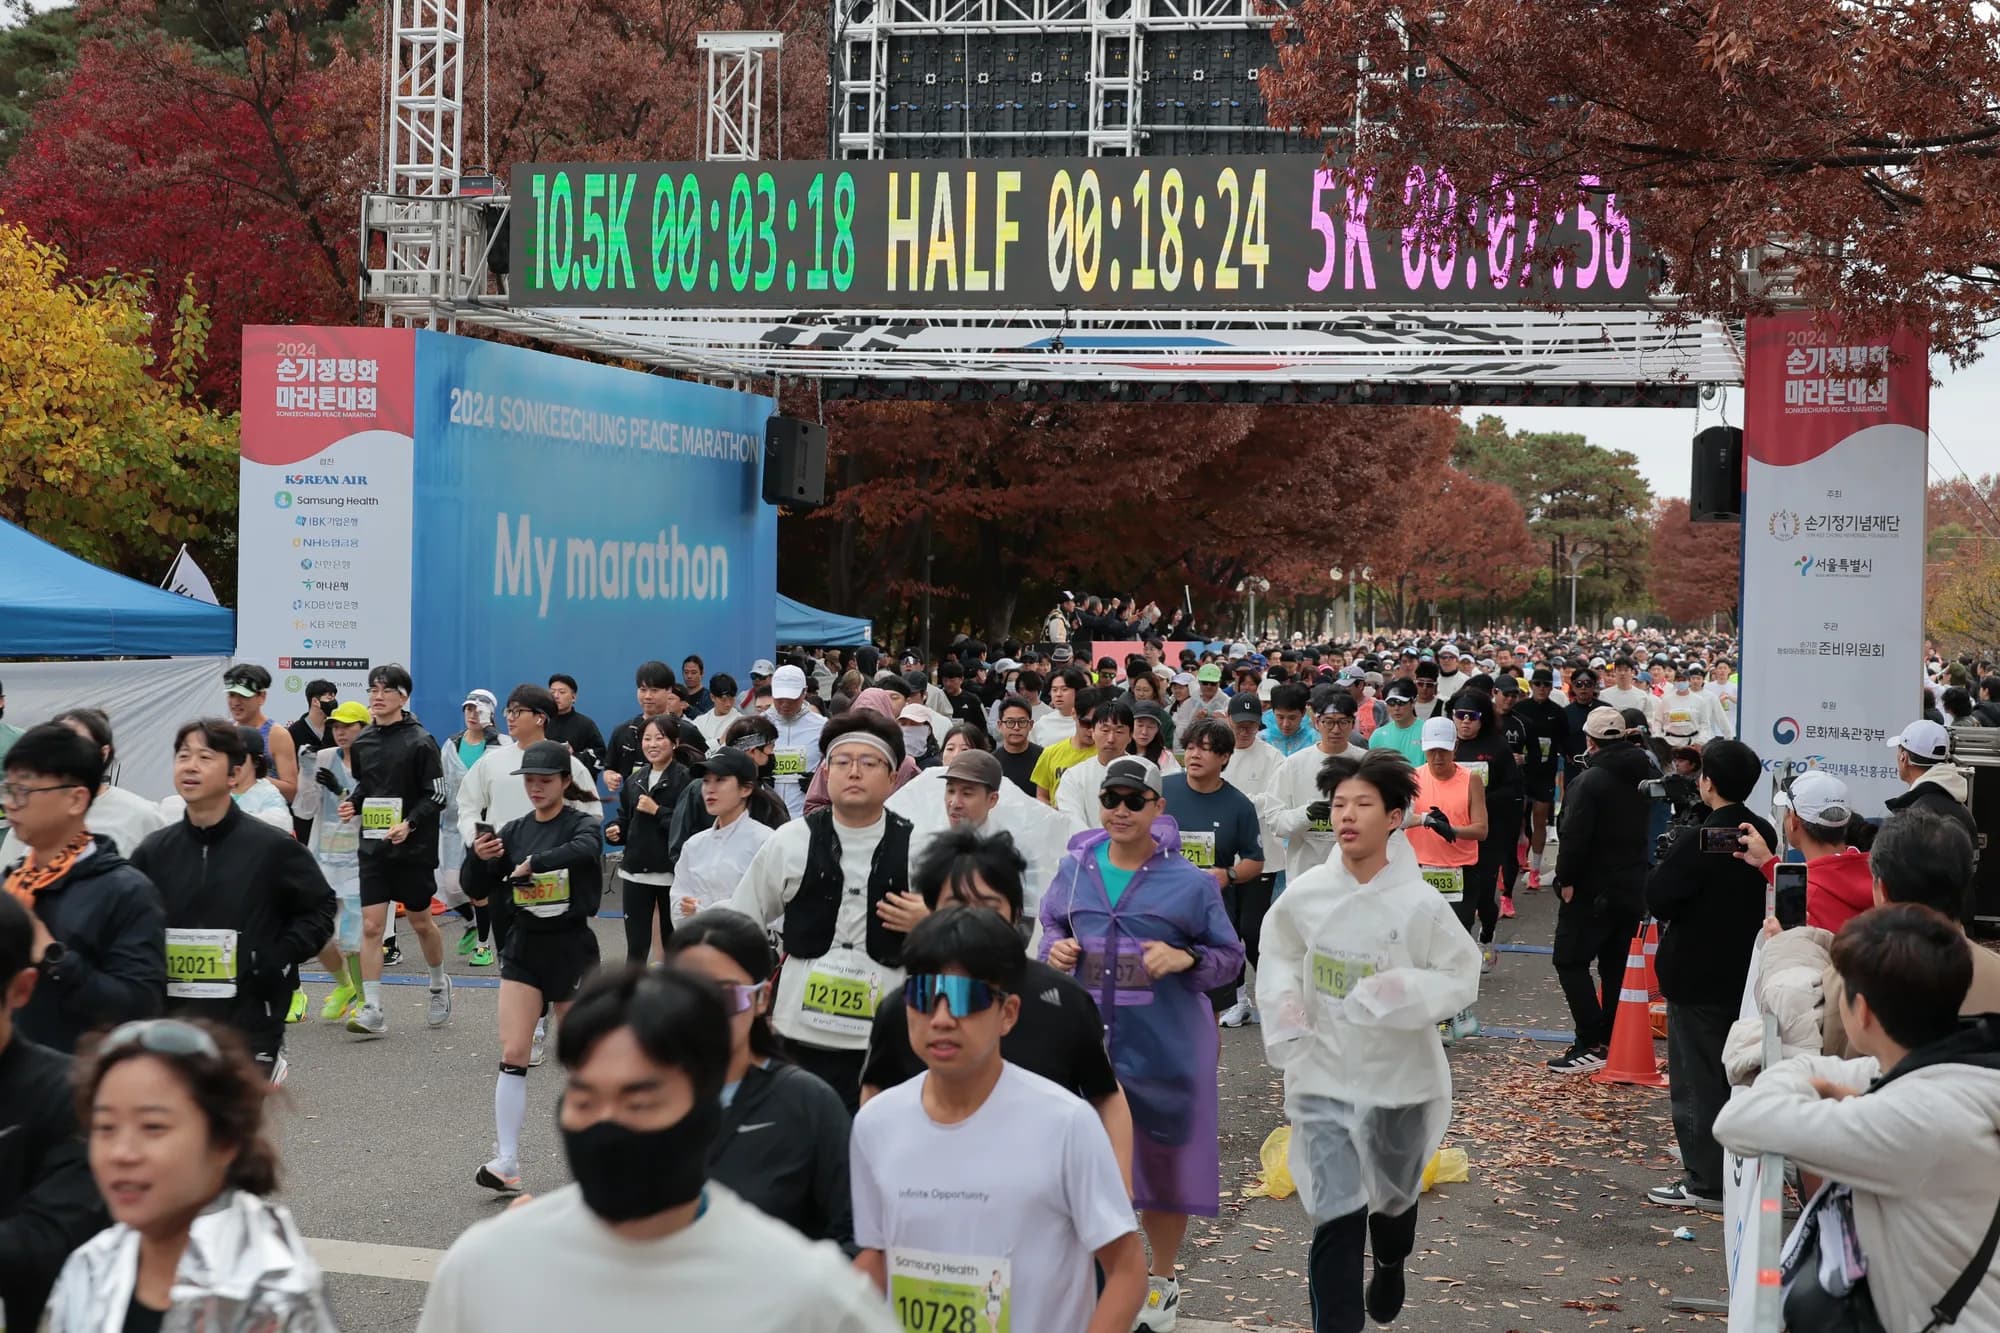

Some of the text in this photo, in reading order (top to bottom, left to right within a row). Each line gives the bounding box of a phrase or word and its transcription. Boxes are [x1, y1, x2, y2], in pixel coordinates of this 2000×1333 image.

[532, 171, 856, 292] 10.5K 00:03:18
[887, 167, 1270, 292] HALF 00:18:24
[1307, 167, 1377, 291] 5K
[1787, 330, 1827, 346] 2024
[276, 342, 317, 357] 2024
[276, 358, 378, 383] 손기정평화
[276, 386, 377, 411] 마라톤대회
[1785, 377, 1888, 406] 마라톤대회
[450, 387, 760, 465] 2024 SONKEECHUNG PEACE MARATHON
[285, 474, 368, 485] KOREAN AIR
[297, 496, 379, 507] Samsung Health
[1804, 514, 1901, 532] 손기정기념재단
[494, 511, 729, 619] My marathon
[1815, 558, 1872, 573] 서울특별시
[1818, 641, 1885, 657] 준비위원회
[1806, 725, 1886, 742] 문화체육관광부
[774, 759, 797, 771] 2502
[1818, 762, 1898, 779] 국민체육진흥공단
[364, 813, 392, 825] 11015
[1426, 878, 1453, 889] 0933
[168, 955, 216, 975] 12021
[809, 983, 864, 1010] 12125
[931, 1187, 990, 1203] Opportunity
[895, 1255, 979, 1276] Samsung Health
[898, 1295, 977, 1333] 10728
